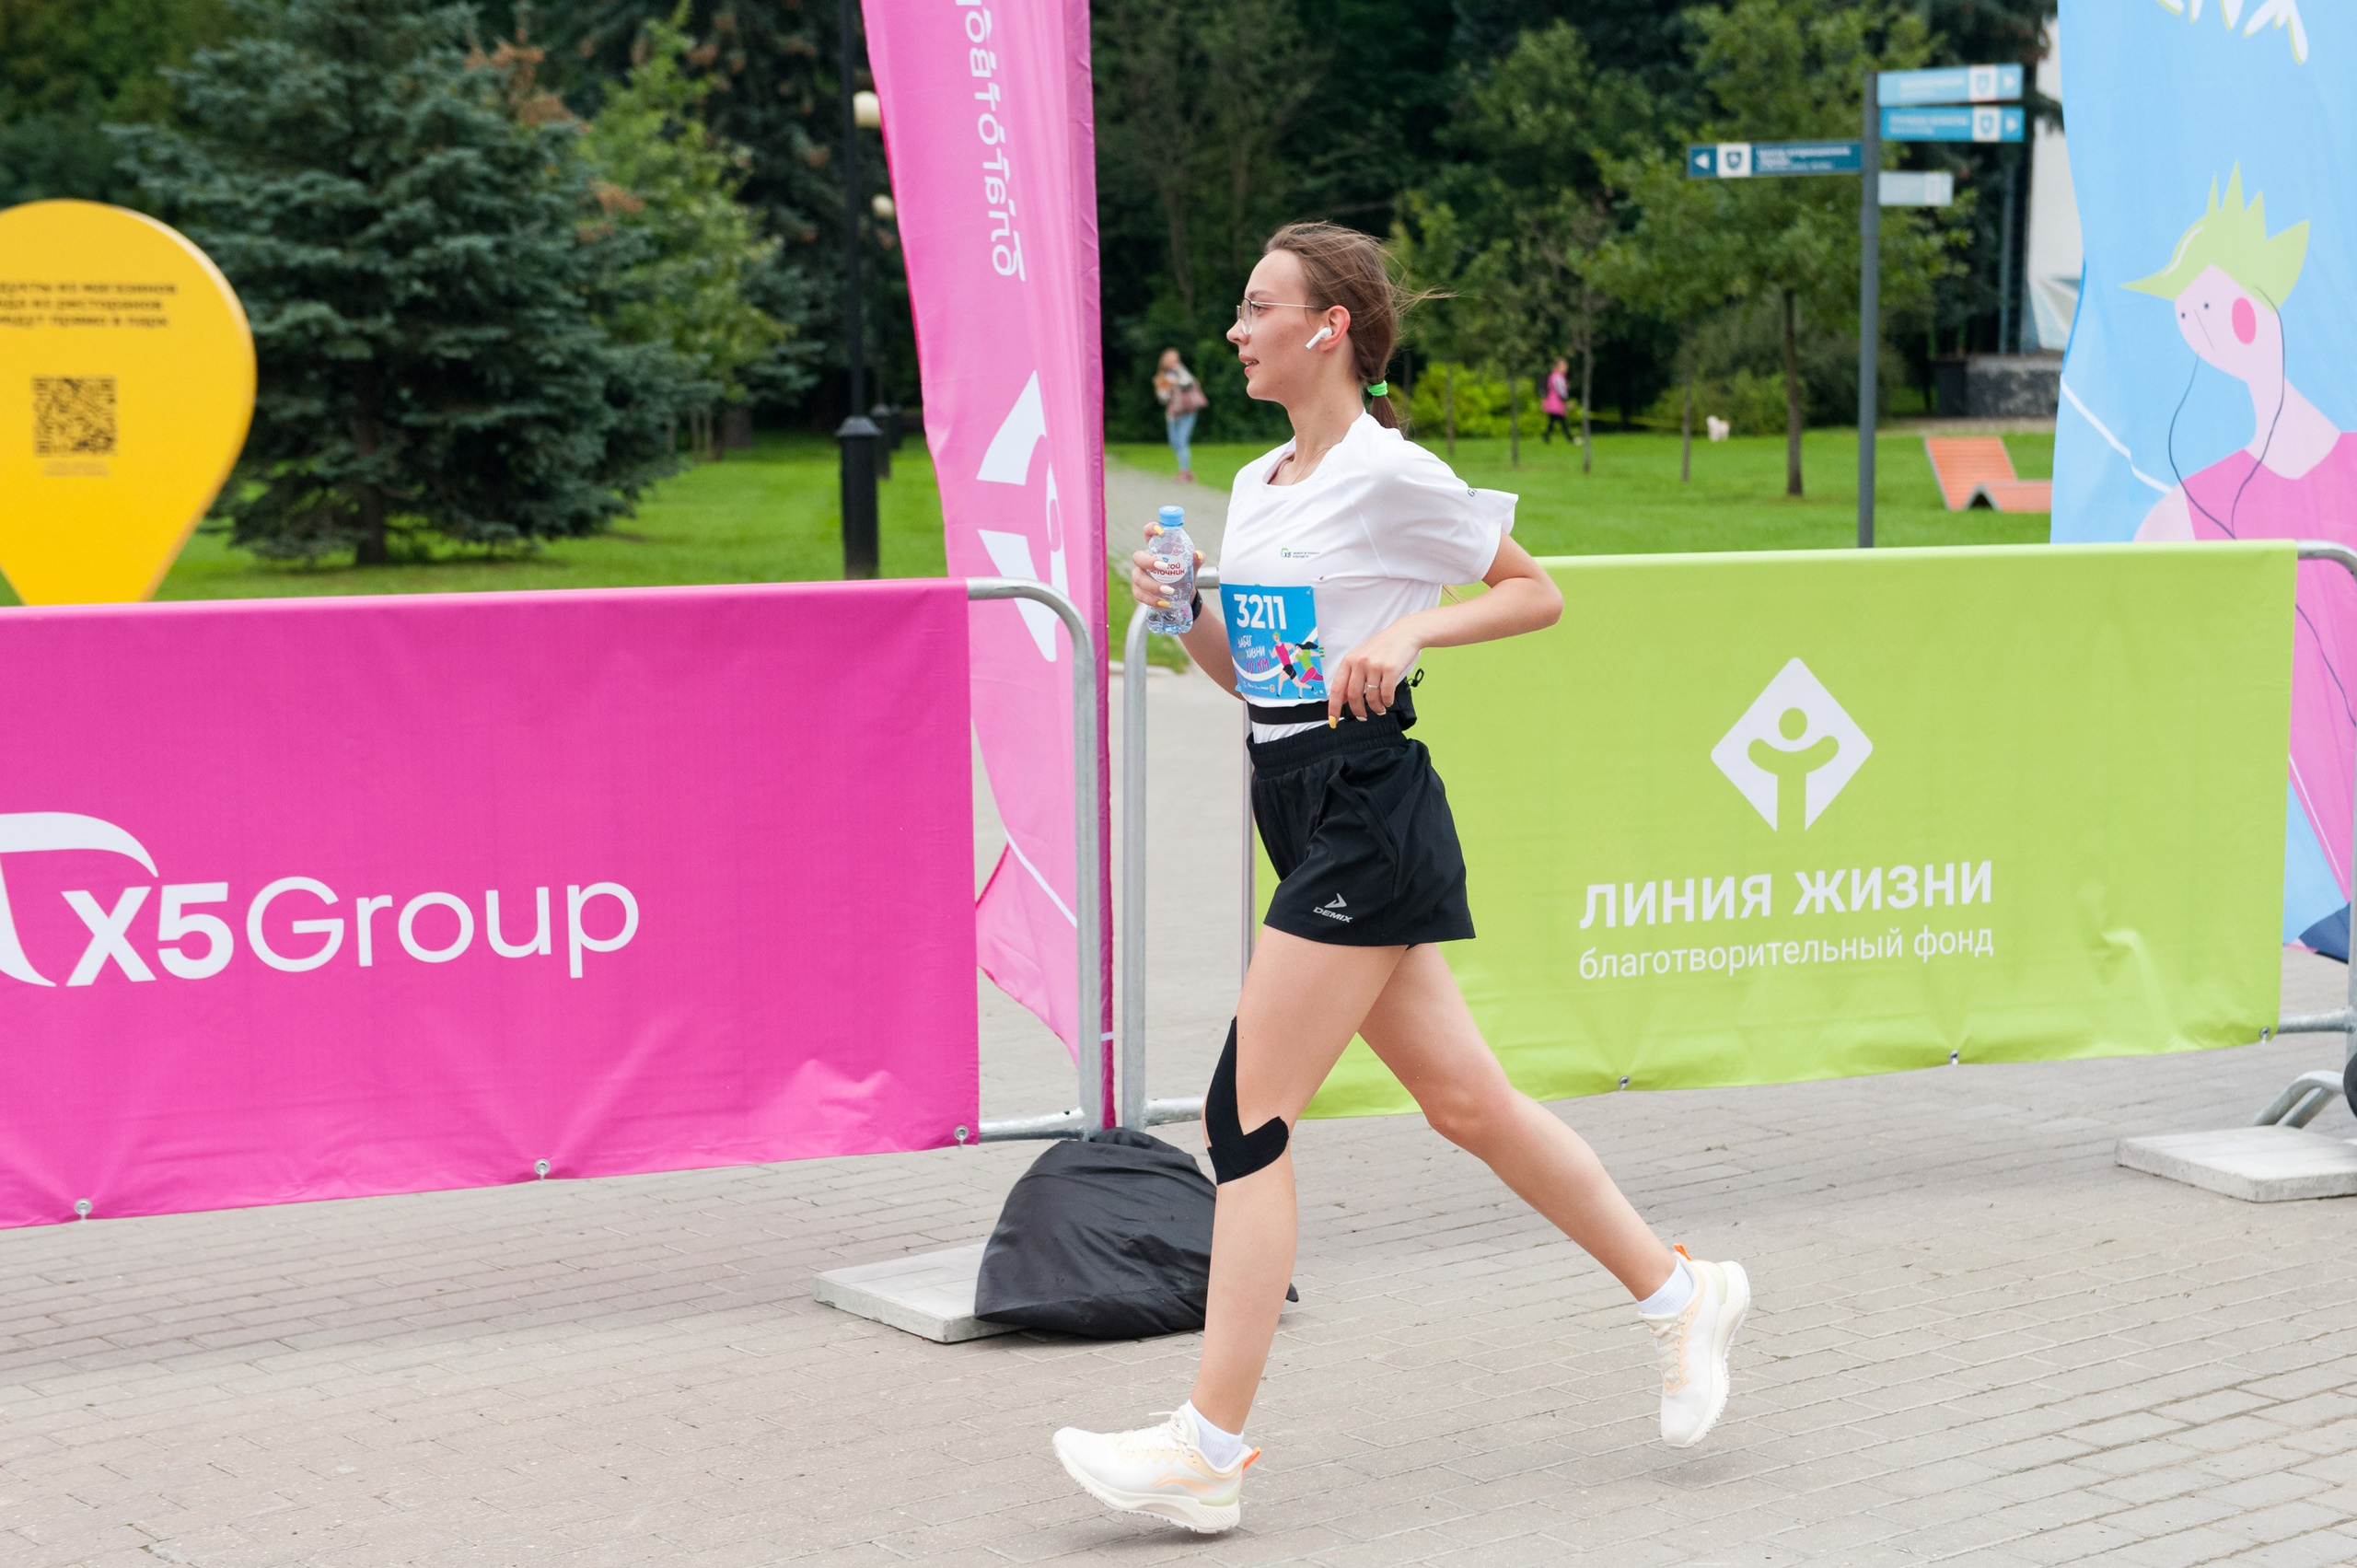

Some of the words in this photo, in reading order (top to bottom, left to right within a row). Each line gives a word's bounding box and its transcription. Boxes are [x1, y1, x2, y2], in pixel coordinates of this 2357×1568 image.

[1234, 594, 1287, 630] 3211
[1313, 906, 1353, 923] DEMIX
[1579, 873, 1772, 929] ЛИНИЯ
[1793, 860, 1992, 915] ЖИЗНИ
[1578, 924, 1904, 980] благотворительный
[1912, 924, 1994, 963] фонд
